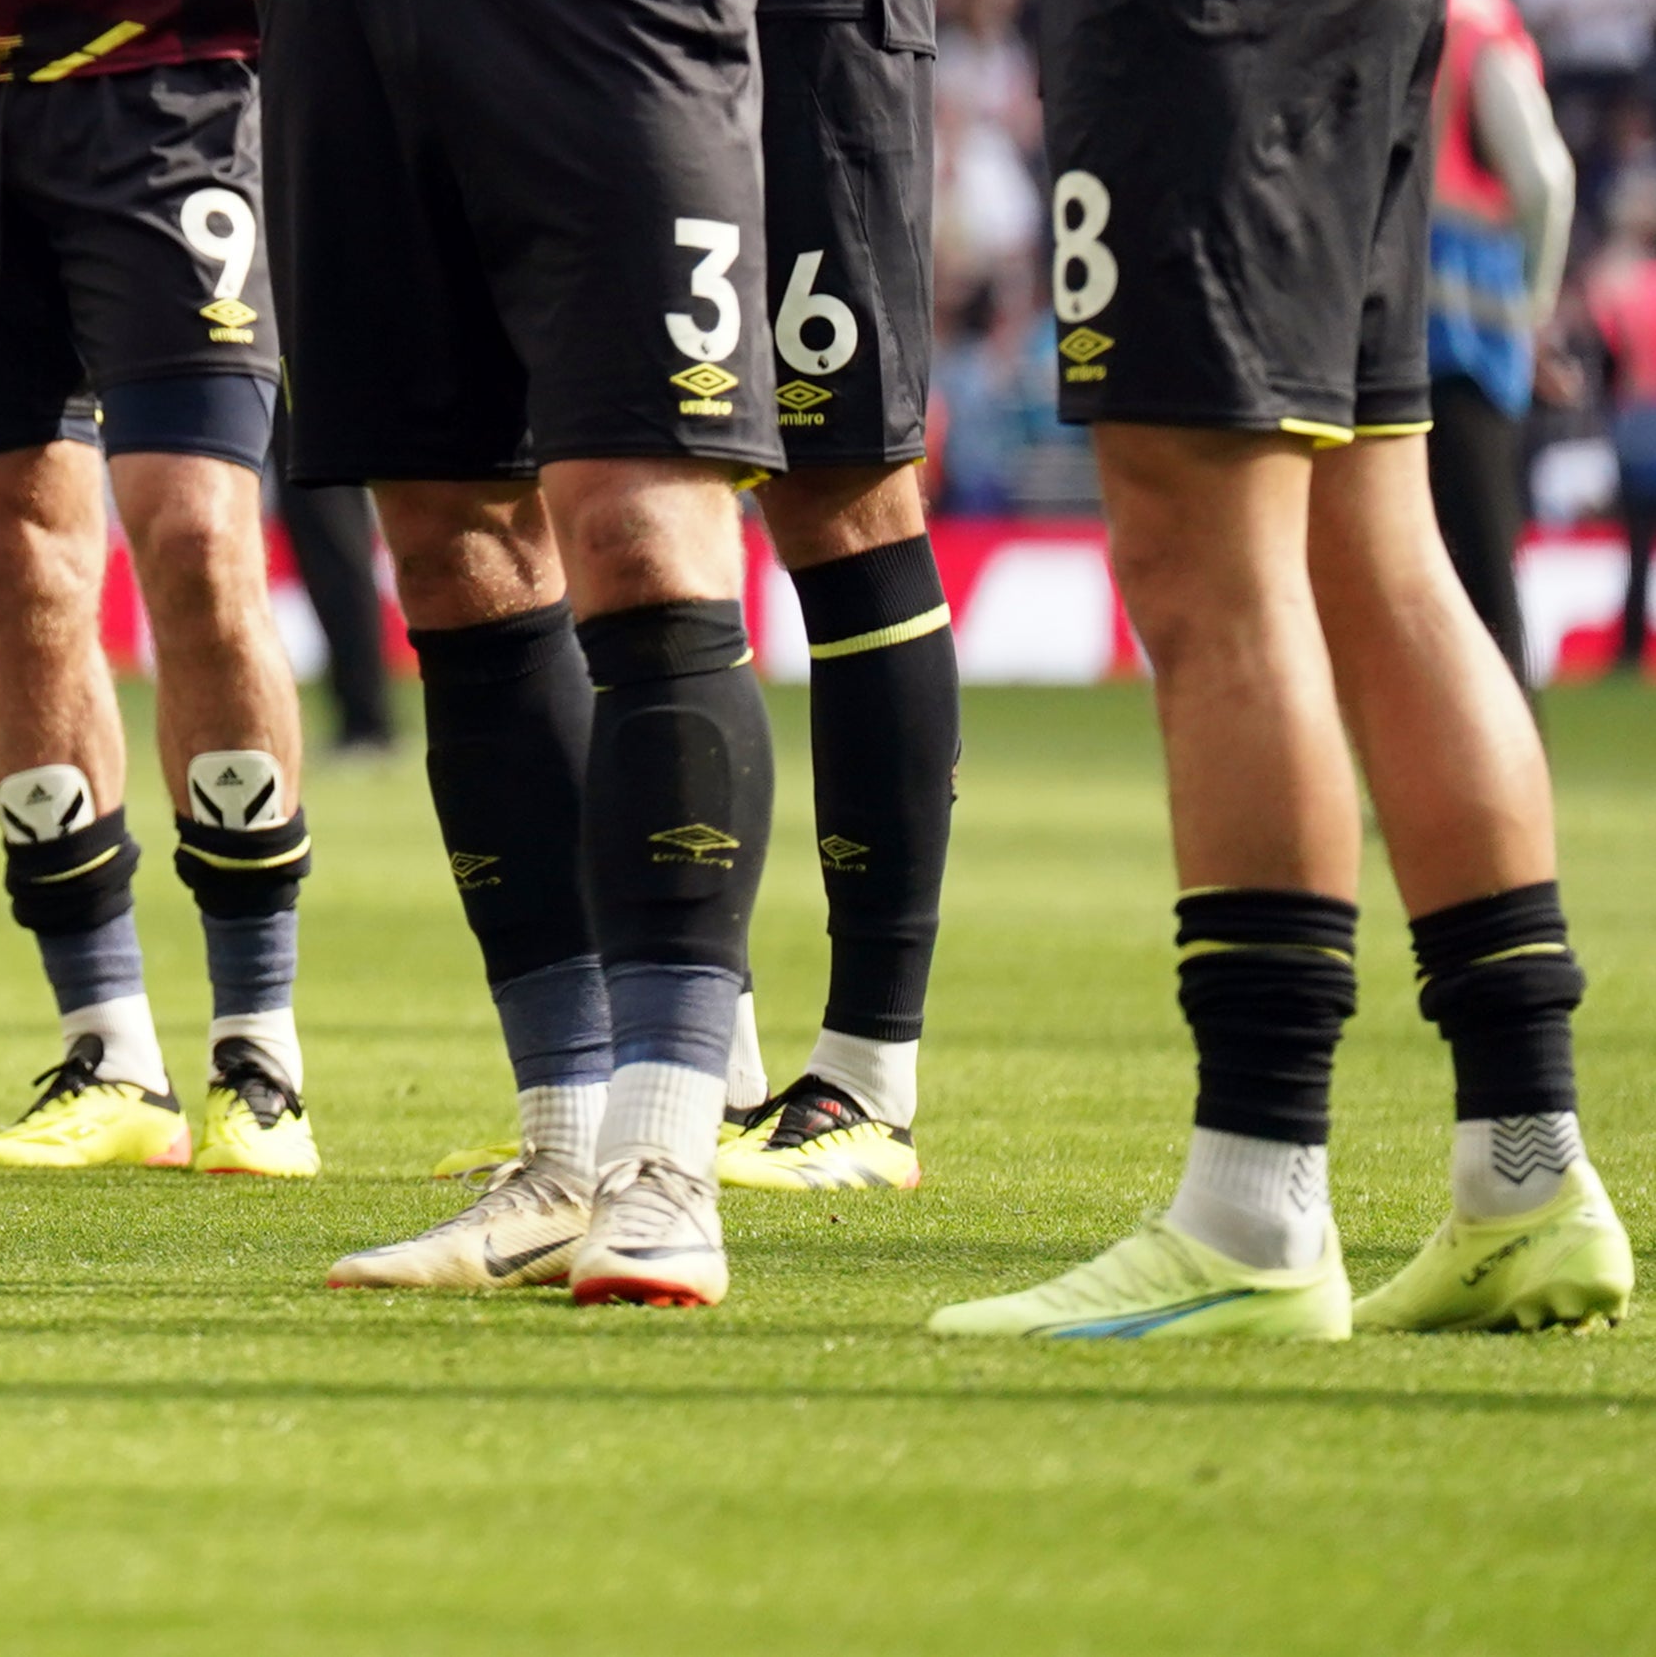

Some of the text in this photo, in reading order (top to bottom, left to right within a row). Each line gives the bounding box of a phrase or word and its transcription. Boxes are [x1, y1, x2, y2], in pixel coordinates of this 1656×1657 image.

[180, 187, 257, 299] 9
[665, 217, 741, 362] 3
[1052, 169, 1120, 324] 8
[775, 249, 858, 376] 6
[679, 397, 733, 417] umbro
[777, 411, 825, 426] umbro
